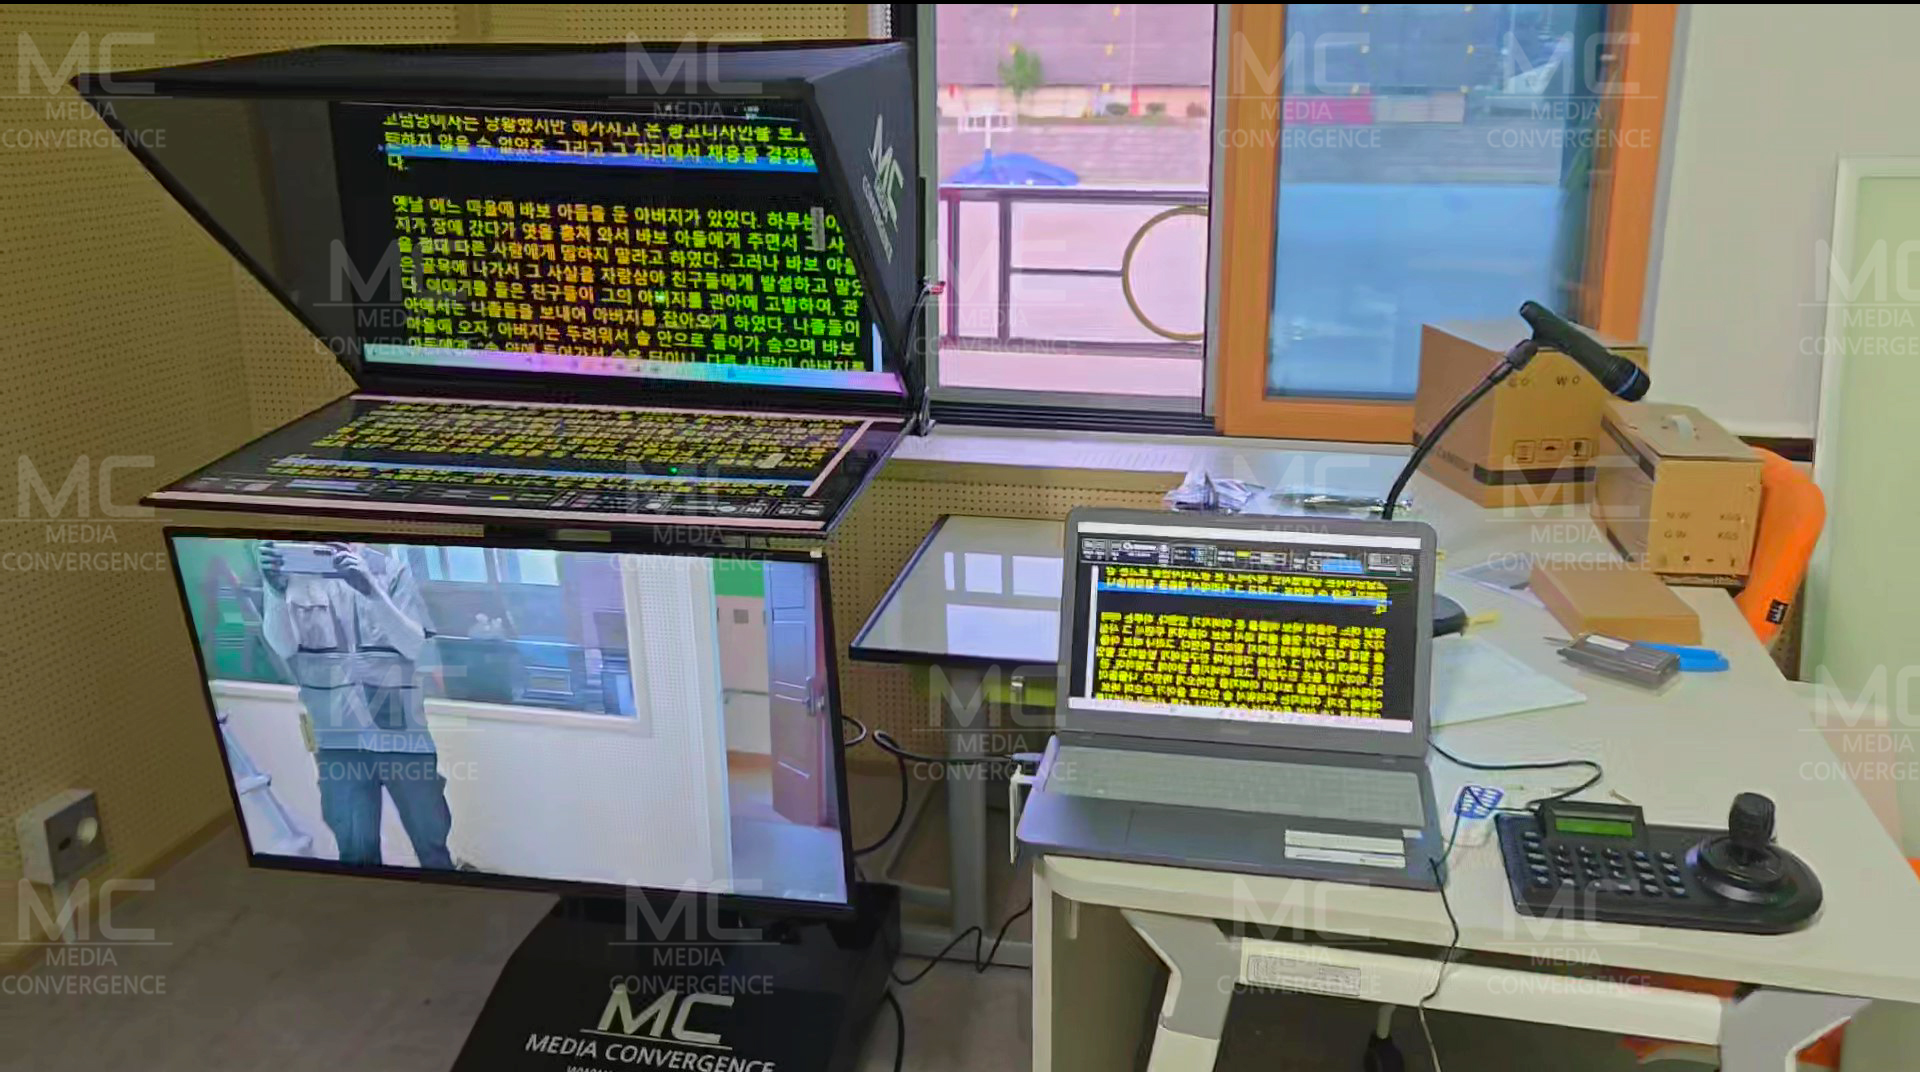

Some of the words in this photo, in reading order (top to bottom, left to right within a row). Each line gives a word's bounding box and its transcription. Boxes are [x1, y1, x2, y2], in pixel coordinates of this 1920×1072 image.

[476, 135, 491, 152] 수
[557, 140, 604, 158] 그리고
[612, 141, 628, 157] 그
[634, 142, 700, 162] 자리에서
[392, 195, 424, 213] 옛날
[429, 198, 463, 215] 어느
[466, 200, 515, 217] 마을에
[519, 202, 552, 219] 바보
[612, 205, 628, 223] 둔
[634, 206, 700, 226] 아버지가
[708, 209, 761, 229] 있었다.
[395, 216, 426, 235] 지가
[431, 218, 465, 237] 장에
[469, 220, 515, 239] 갔다가
[597, 225, 630, 245] 와서
[635, 228, 669, 246] 바보
[674, 229, 741, 249] 아들에게
[747, 232, 798, 252] 주면서
[398, 236, 412, 253] 을
[454, 238, 487, 257] 다른
[490, 240, 556, 260] 사람에게
[615, 246, 665, 265] 말라고
[729, 252, 778, 271] 그러나
[786, 254, 820, 273] 바보
[400, 256, 415, 273] 은
[472, 260, 520, 280] 나가서
[525, 263, 542, 278] 그
[547, 263, 594, 283] 사실을
[599, 267, 666, 287] 자랑삼아
[671, 269, 753, 291] 친구들에게
[760, 274, 828, 294] 발설하고
[494, 281, 527, 300] 들은
[530, 283, 595, 304] 친구들이
[599, 287, 632, 306] 그의
[708, 293, 759, 312] 관아에
[842, 299, 859, 317] 관
[540, 304, 587, 323] 보내어
[592, 307, 656, 327] 아버지를
[663, 310, 727, 332] 잡아오게
[498, 321, 561, 341] 아버지는
[566, 325, 629, 345] 두려워서
[657, 331, 706, 348] 안으로
[767, 336, 816, 355] 숨으며
[822, 339, 857, 358] 바보
[597, 982, 734, 1044] MC
[525, 1033, 597, 1059] MEDIA
[605, 1043, 776, 1072] CONVERGENCE
